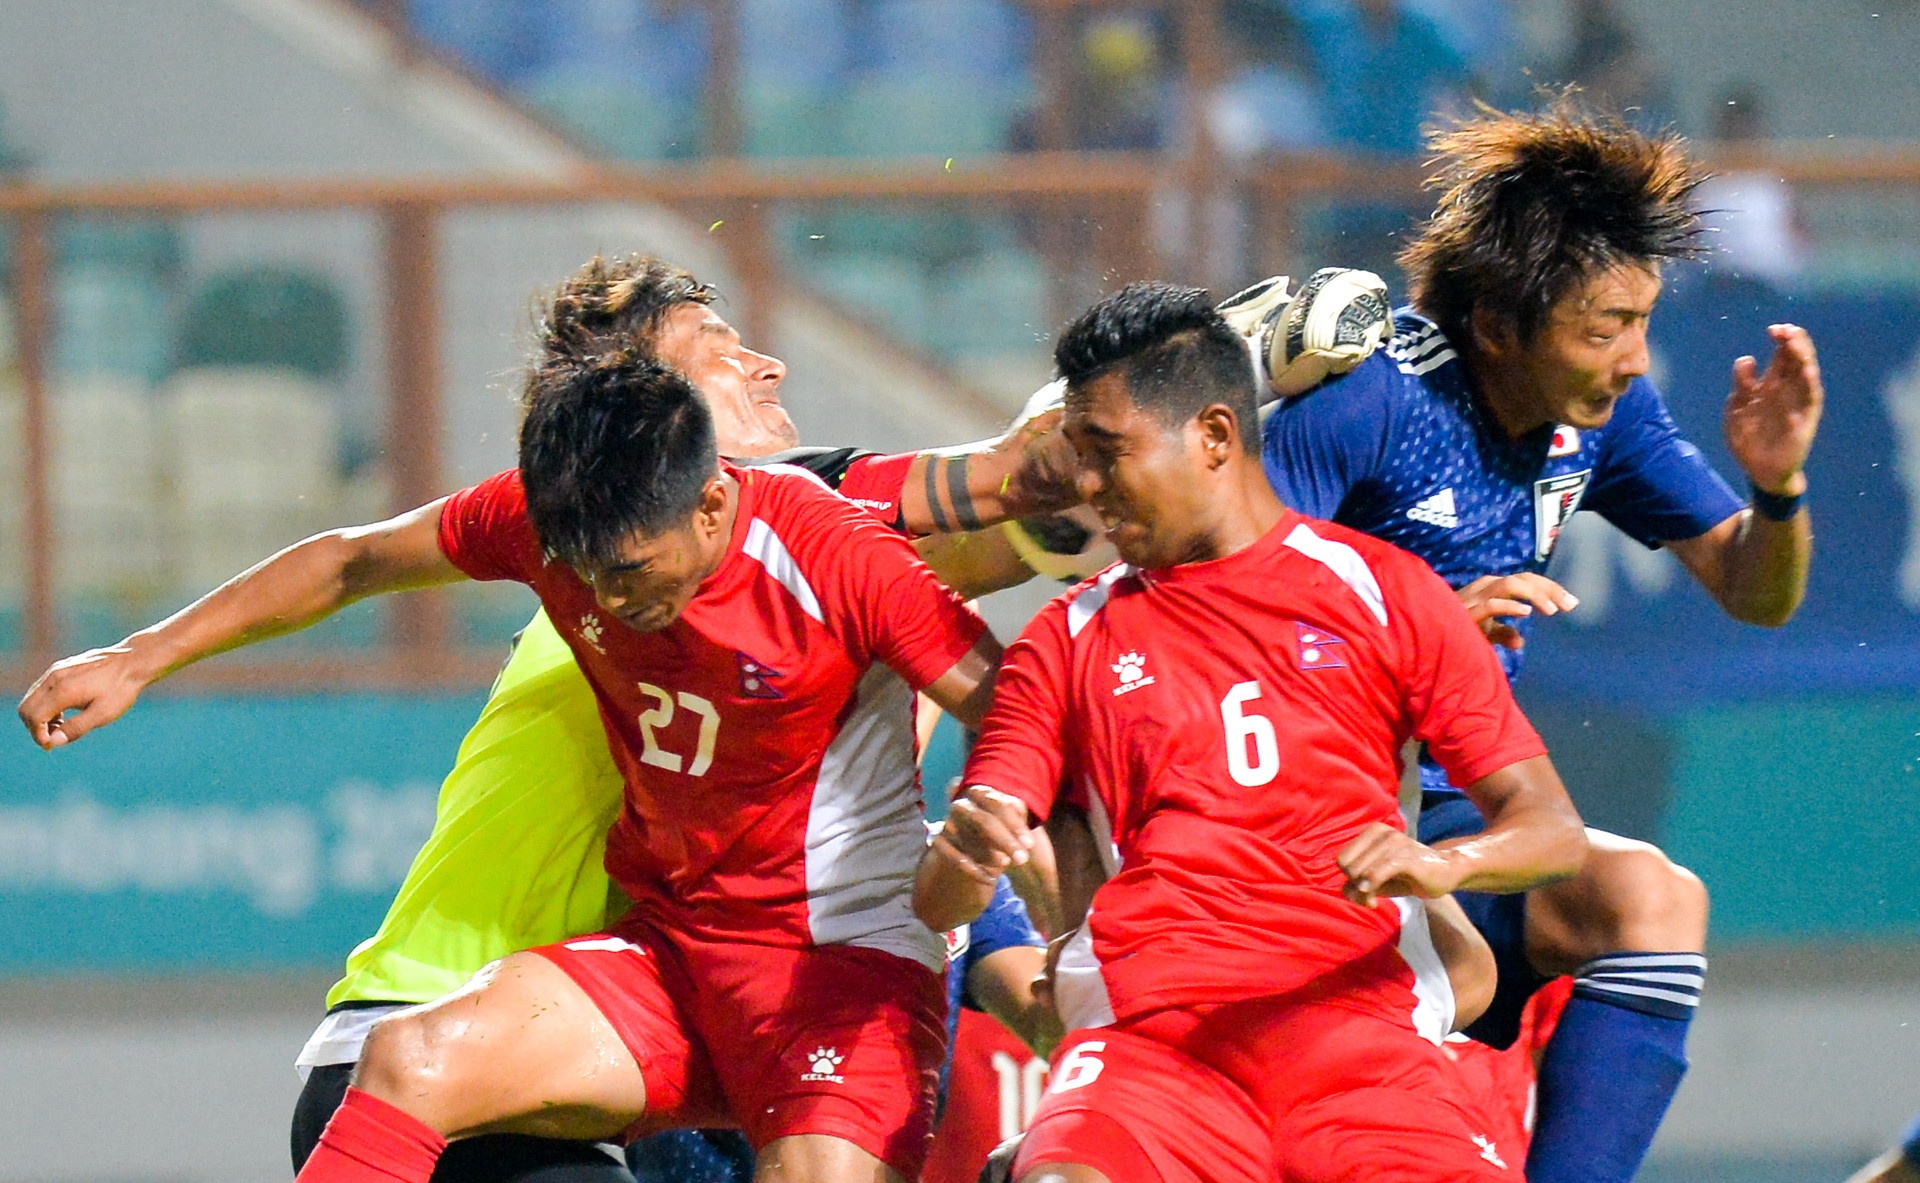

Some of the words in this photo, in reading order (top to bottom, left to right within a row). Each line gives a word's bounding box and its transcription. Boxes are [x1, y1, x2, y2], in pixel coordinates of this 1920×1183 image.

[1406, 507, 1459, 529] adidas
[1112, 675, 1155, 696] KELME
[638, 681, 721, 777] 27
[1219, 680, 1281, 788] 6
[800, 1073, 845, 1085] KELME
[1049, 1040, 1107, 1095] 6
